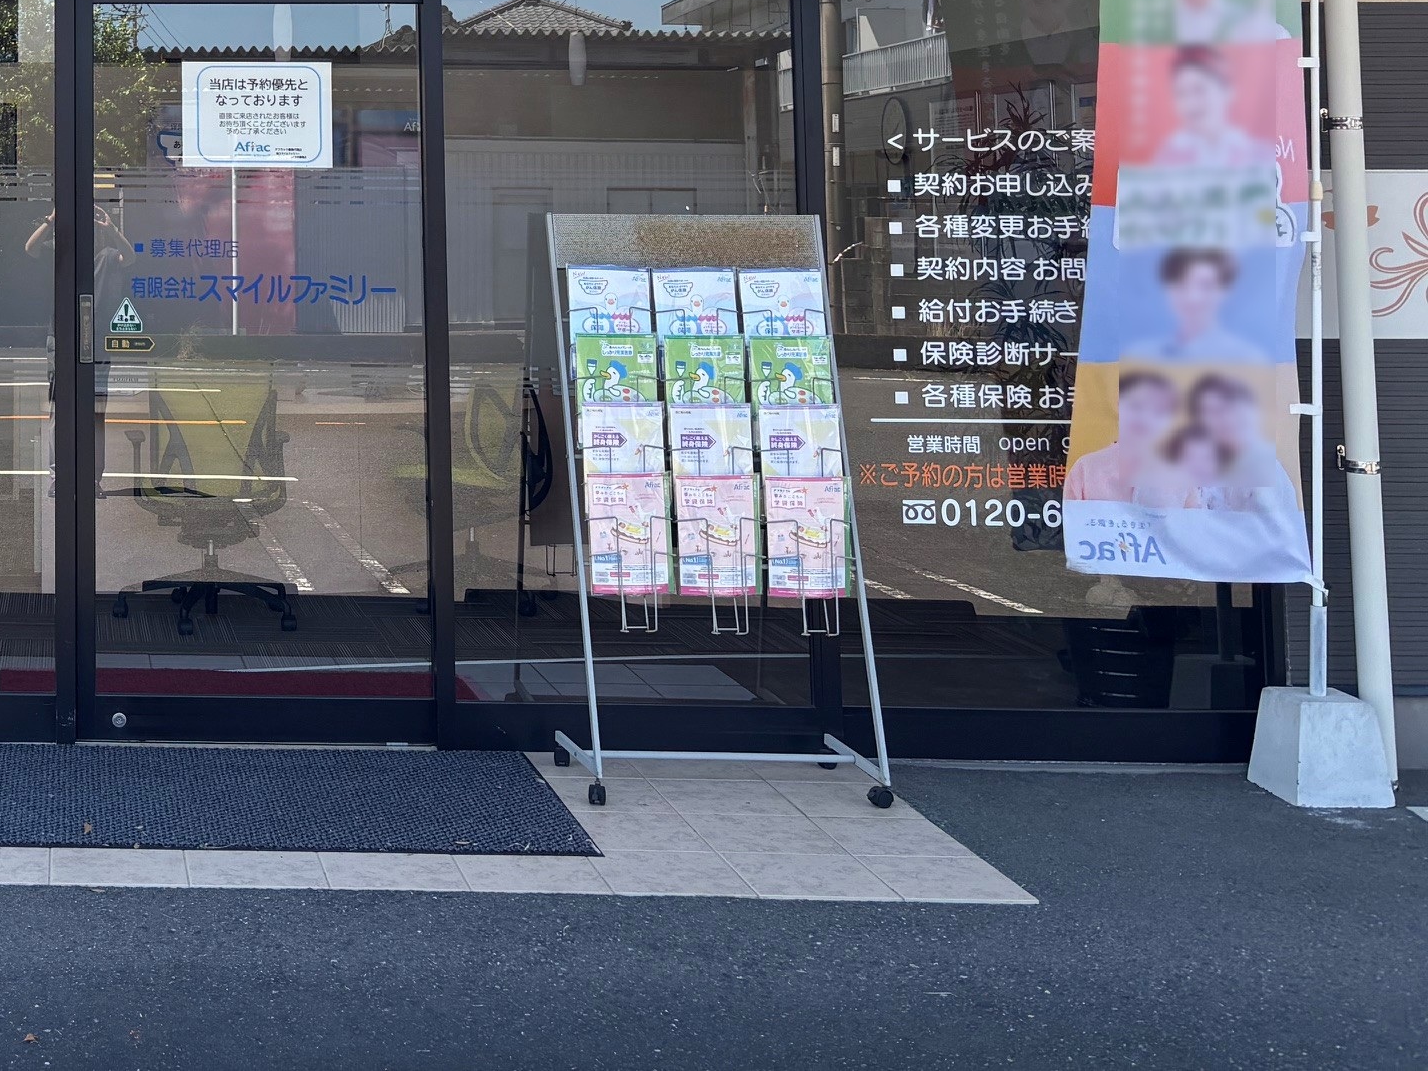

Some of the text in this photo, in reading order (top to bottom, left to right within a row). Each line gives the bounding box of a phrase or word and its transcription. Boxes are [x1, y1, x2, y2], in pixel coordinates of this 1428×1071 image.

[209, 78, 309, 91] 当店は予約優先と
[215, 94, 303, 107] なっております
[914, 172, 1092, 196] 契約お申し込み
[149, 238, 240, 259] 募集代理店
[917, 257, 1026, 281] 契約内容
[131, 273, 397, 305] 有限会社スマイルファミリー
[918, 299, 1079, 323] 給付お手続き
[920, 341, 1079, 366] 保険診断サー
[921, 384, 1074, 409] 各種保険 お
[907, 435, 980, 454] 営業時間
[998, 436, 1050, 453] open
[941, 499, 1062, 528] 0120-6
